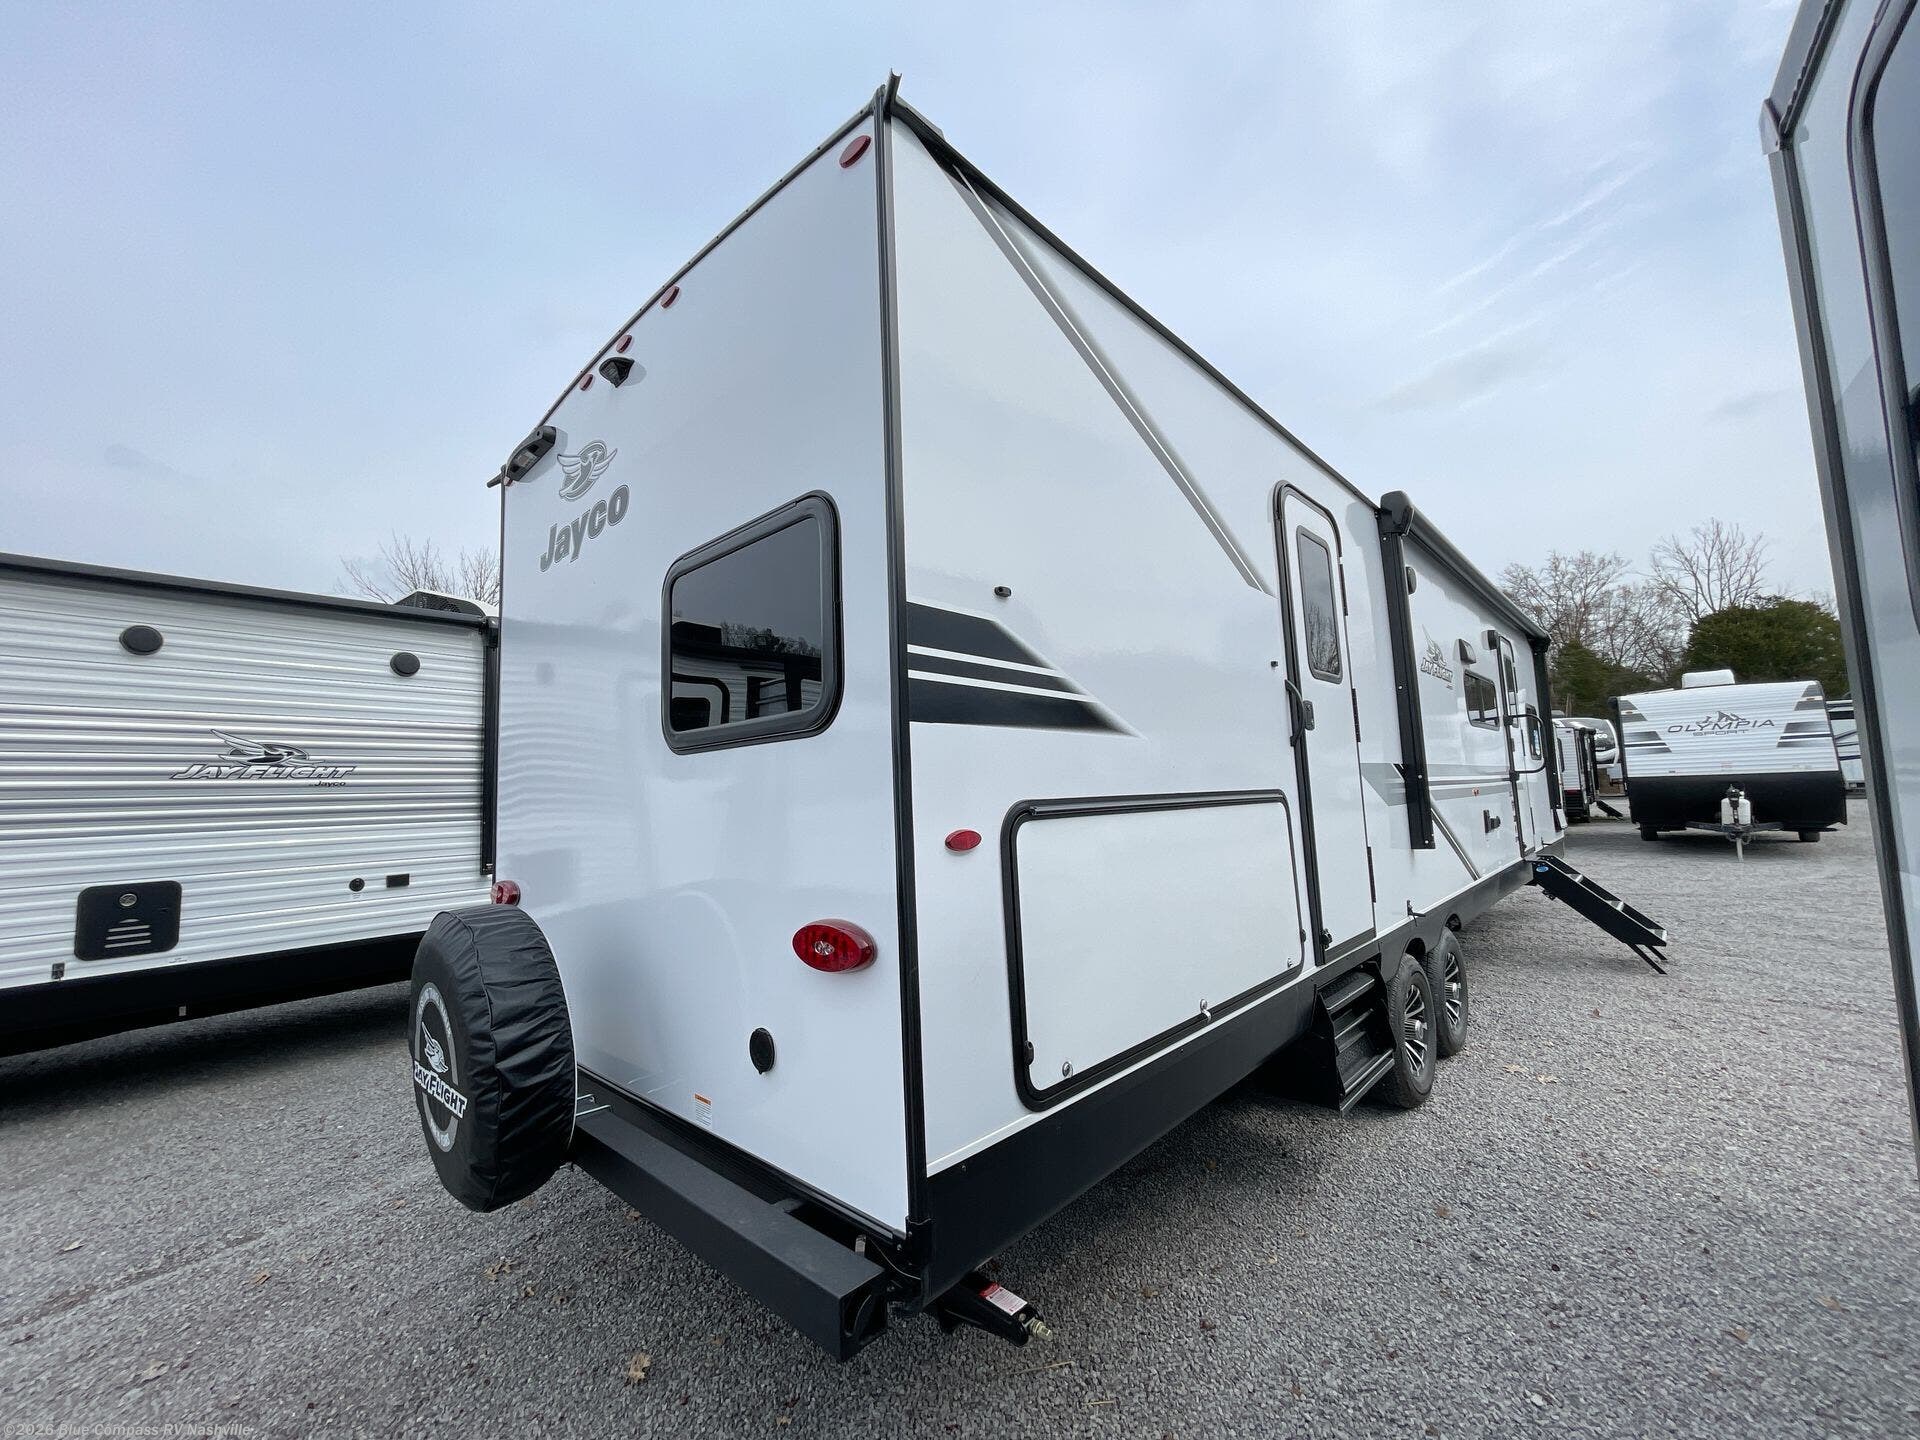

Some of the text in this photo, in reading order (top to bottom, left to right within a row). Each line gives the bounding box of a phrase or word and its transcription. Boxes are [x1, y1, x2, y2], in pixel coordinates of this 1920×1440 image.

[540, 484, 630, 573] Jayco
[1667, 719, 1776, 733] OLYMPIA
[1692, 729, 1749, 737] SPORT
[314, 780, 346, 788] Jayco
